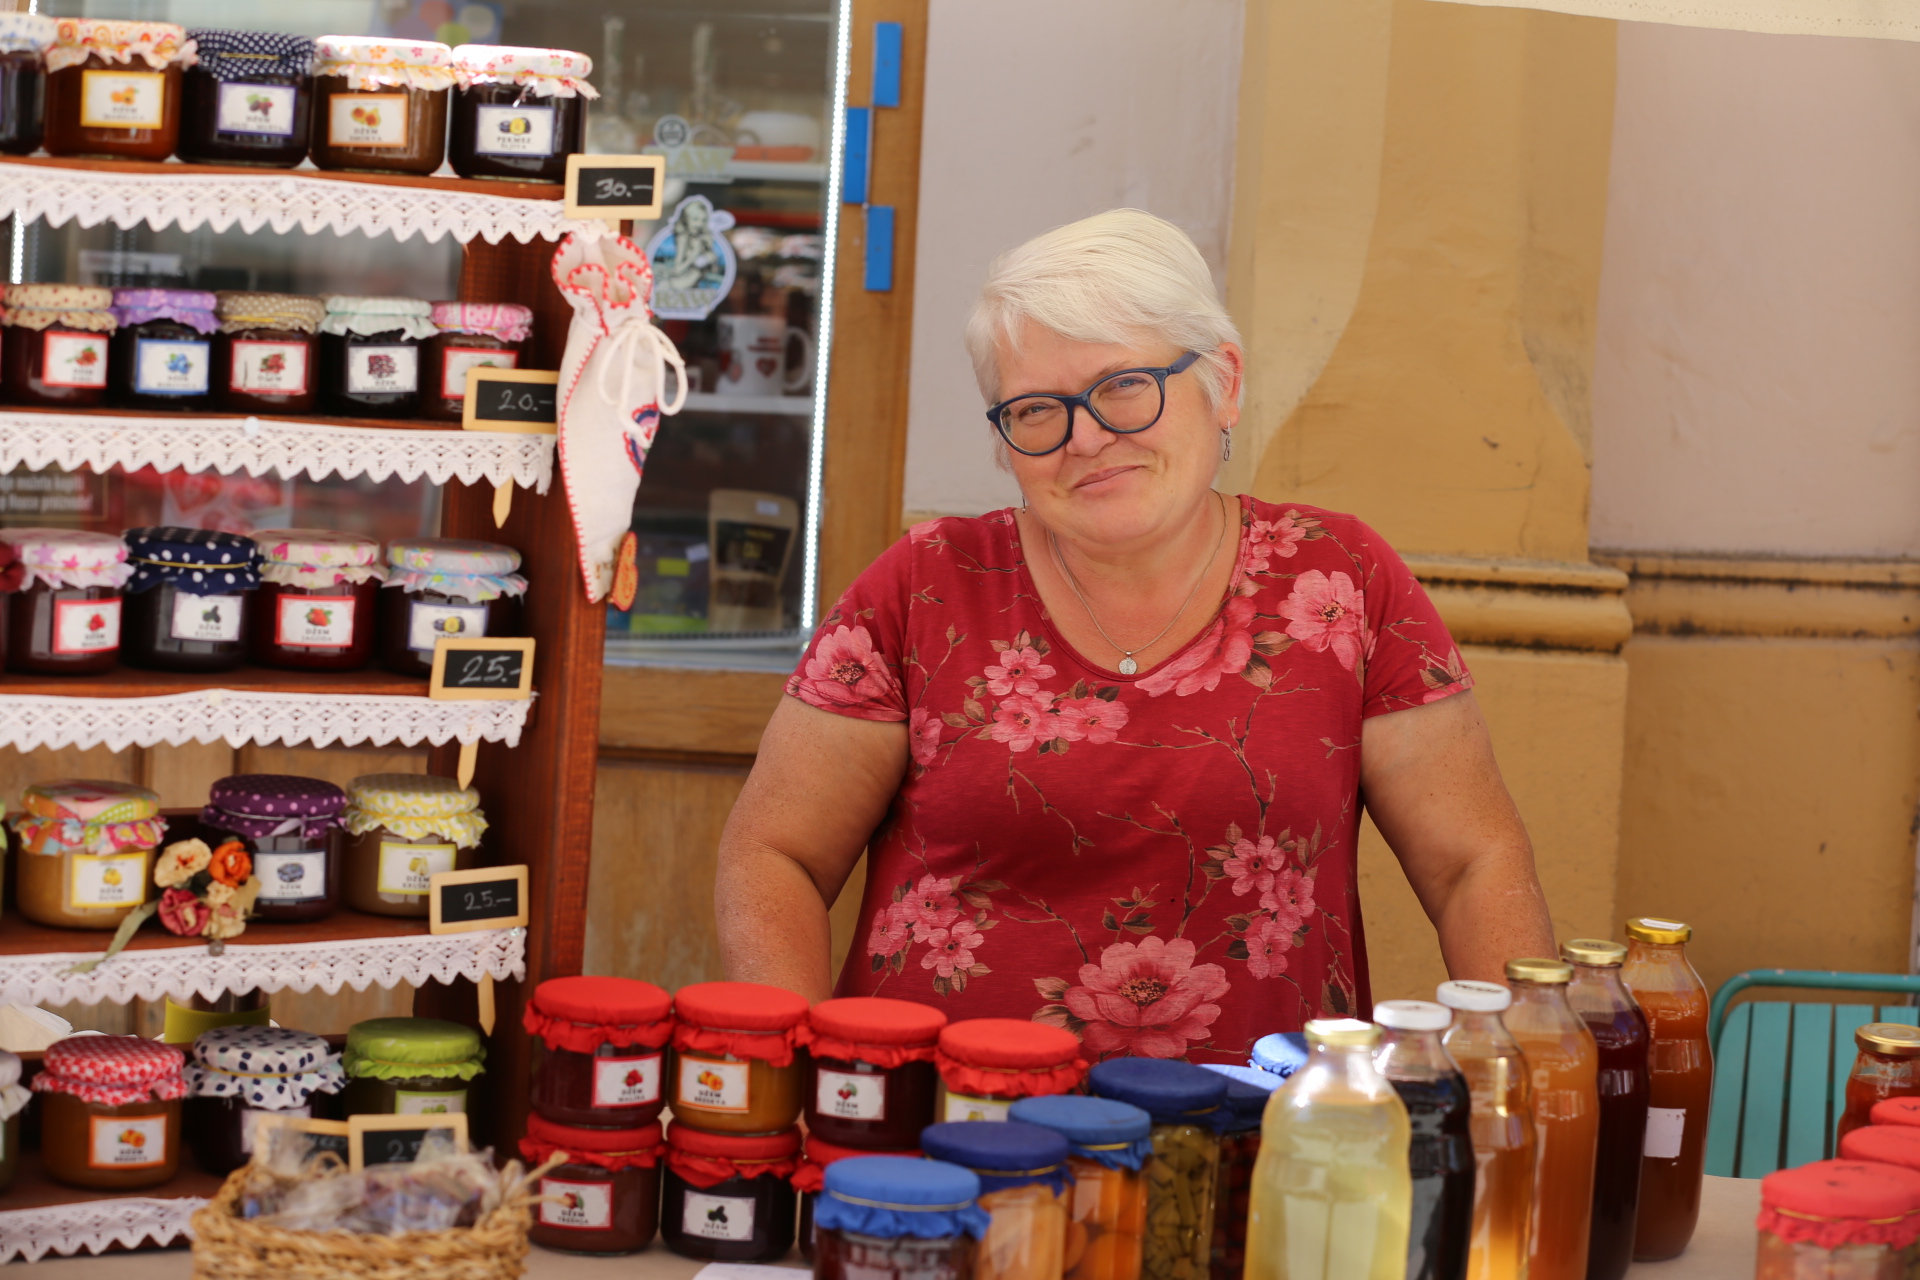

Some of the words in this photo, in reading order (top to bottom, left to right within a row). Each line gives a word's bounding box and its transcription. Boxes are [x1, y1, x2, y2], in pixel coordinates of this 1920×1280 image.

[305, 627, 330, 636] DŽEM
[406, 874, 430, 883] DŽEM
[618, 1087, 644, 1096] DŽEM
[698, 1089, 722, 1099] DŽEM
[835, 1100, 859, 1109] DŽEM
[560, 1209, 586, 1219] DŽEM
[703, 1222, 729, 1231] DŽEM
